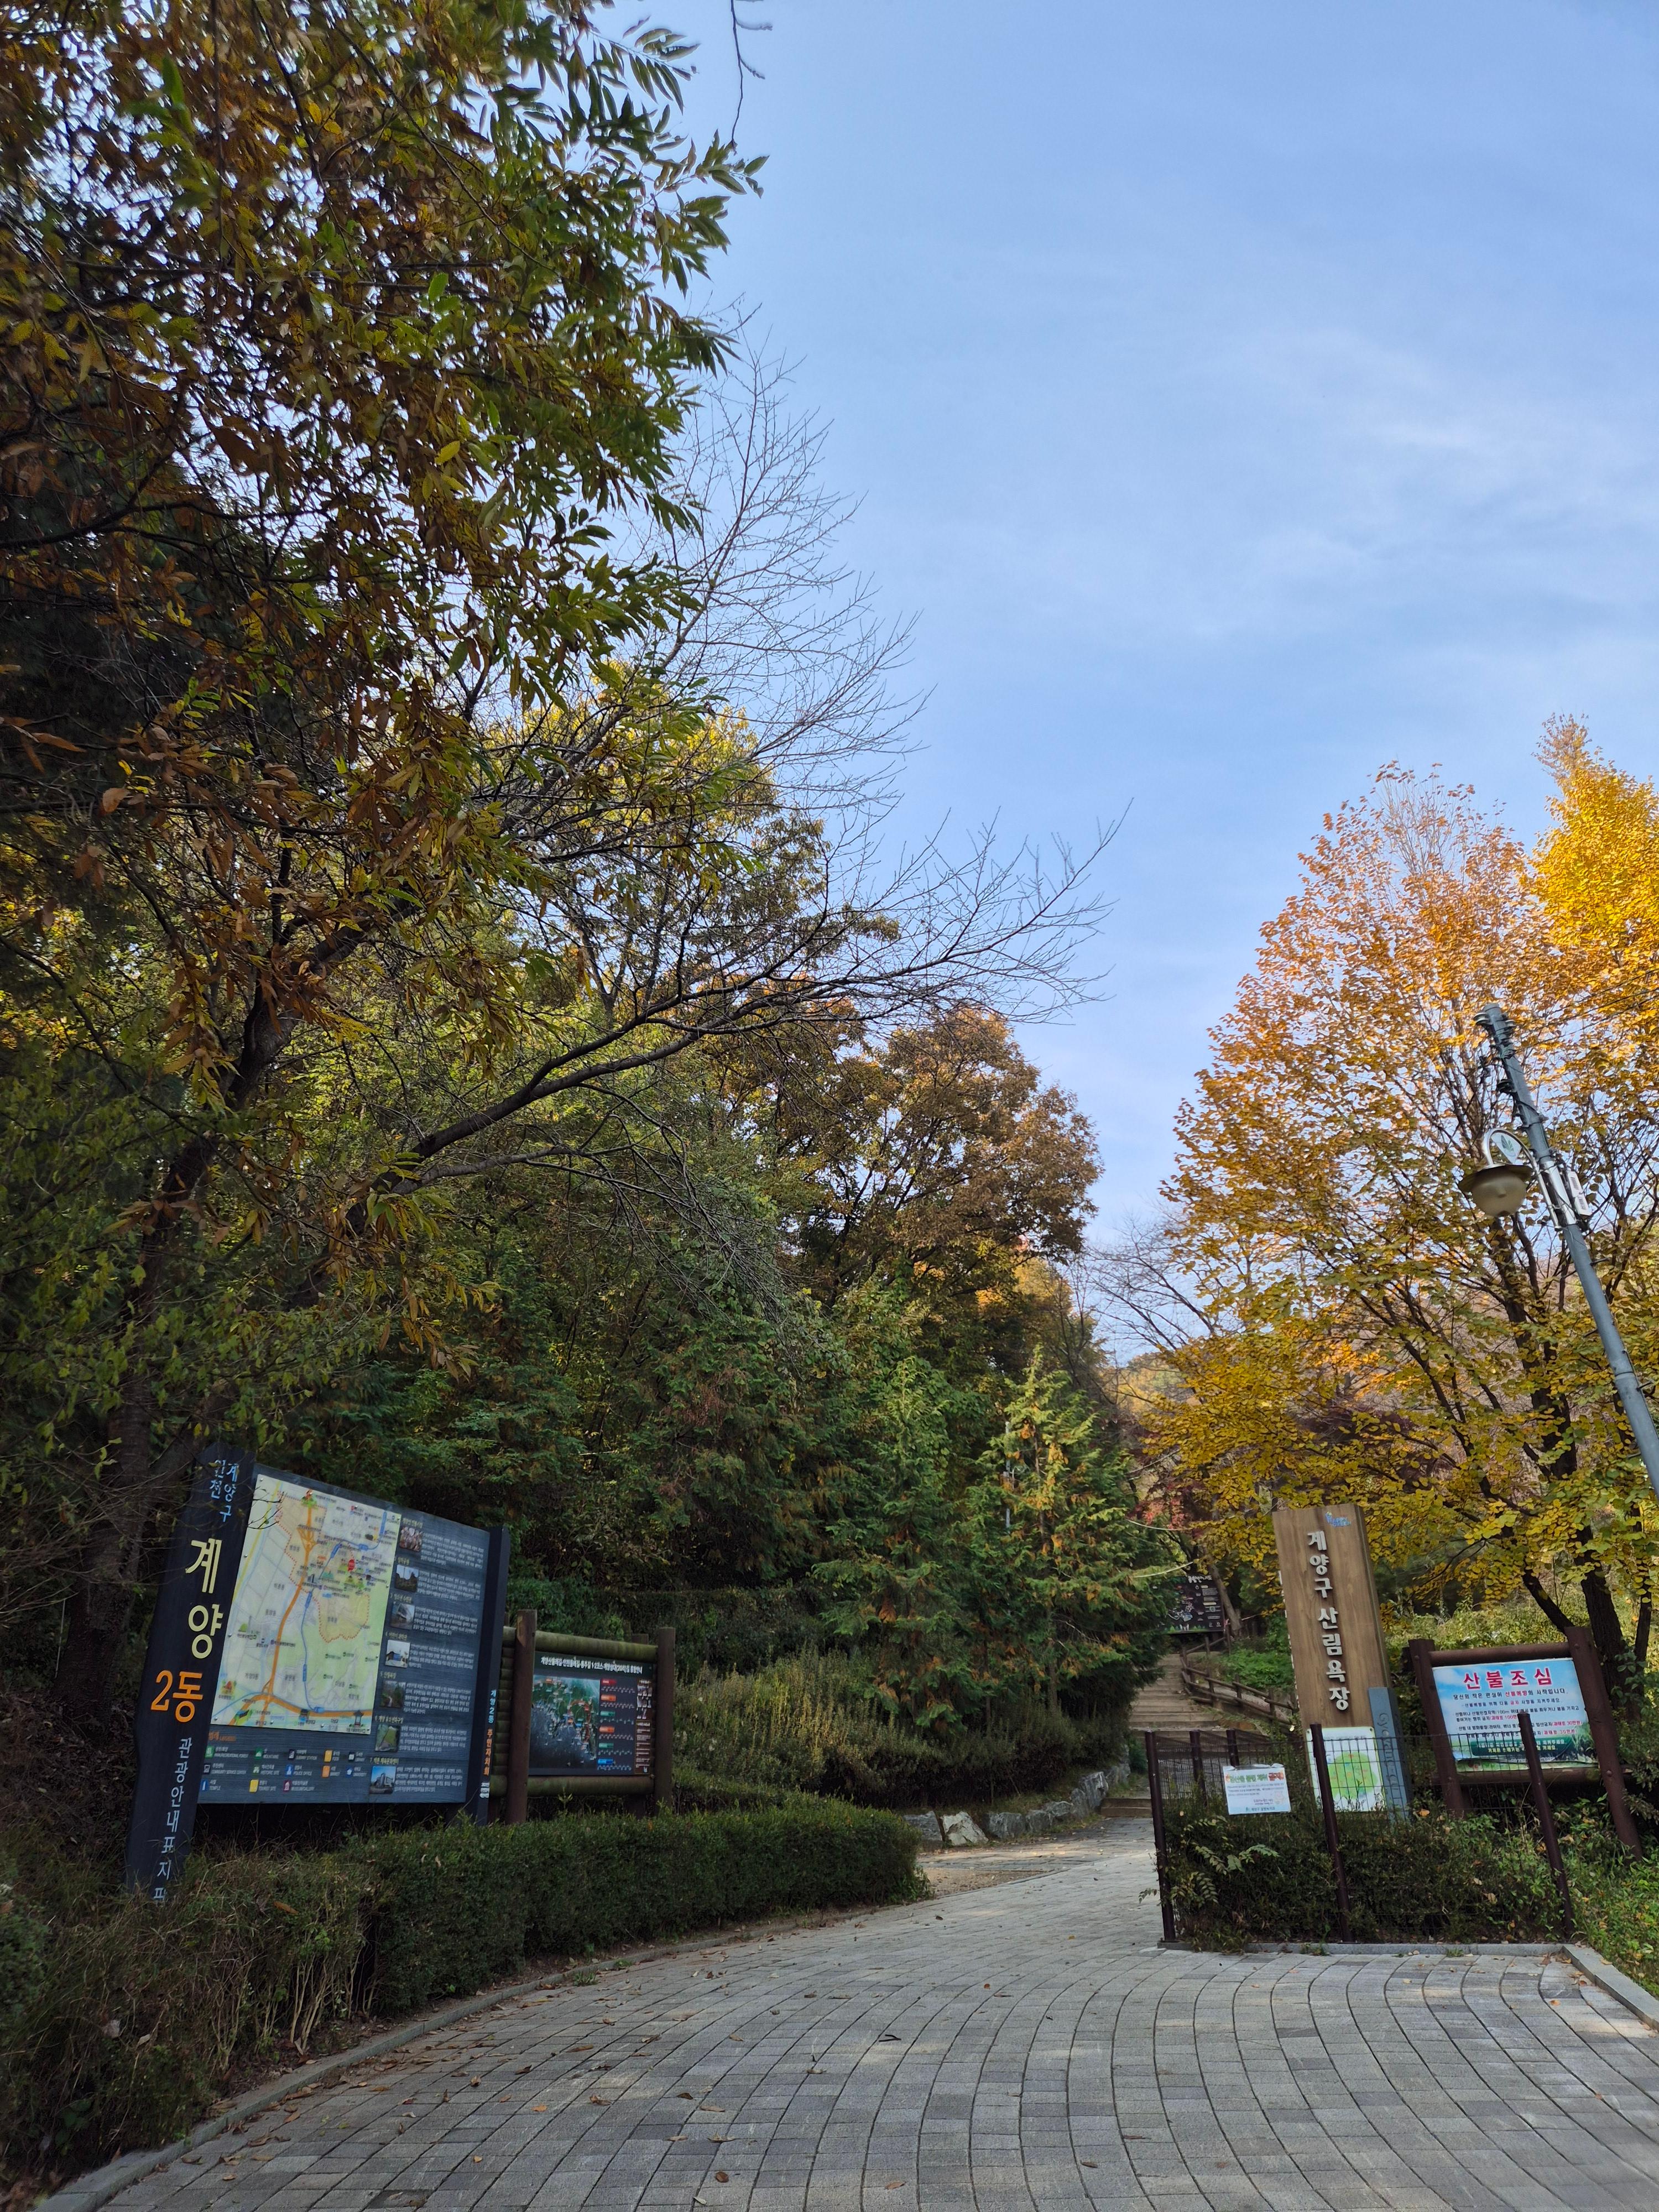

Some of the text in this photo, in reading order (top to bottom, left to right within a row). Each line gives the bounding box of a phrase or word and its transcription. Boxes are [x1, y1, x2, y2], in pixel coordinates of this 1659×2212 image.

[220, 1463, 239, 1523] 계양구
[1307, 1531, 1333, 1598] 계양구
[1317, 1607, 1350, 1710] 산림욕장
[1463, 1667, 1552, 1690] 산불조심
[151, 1670, 204, 1723] 2동
